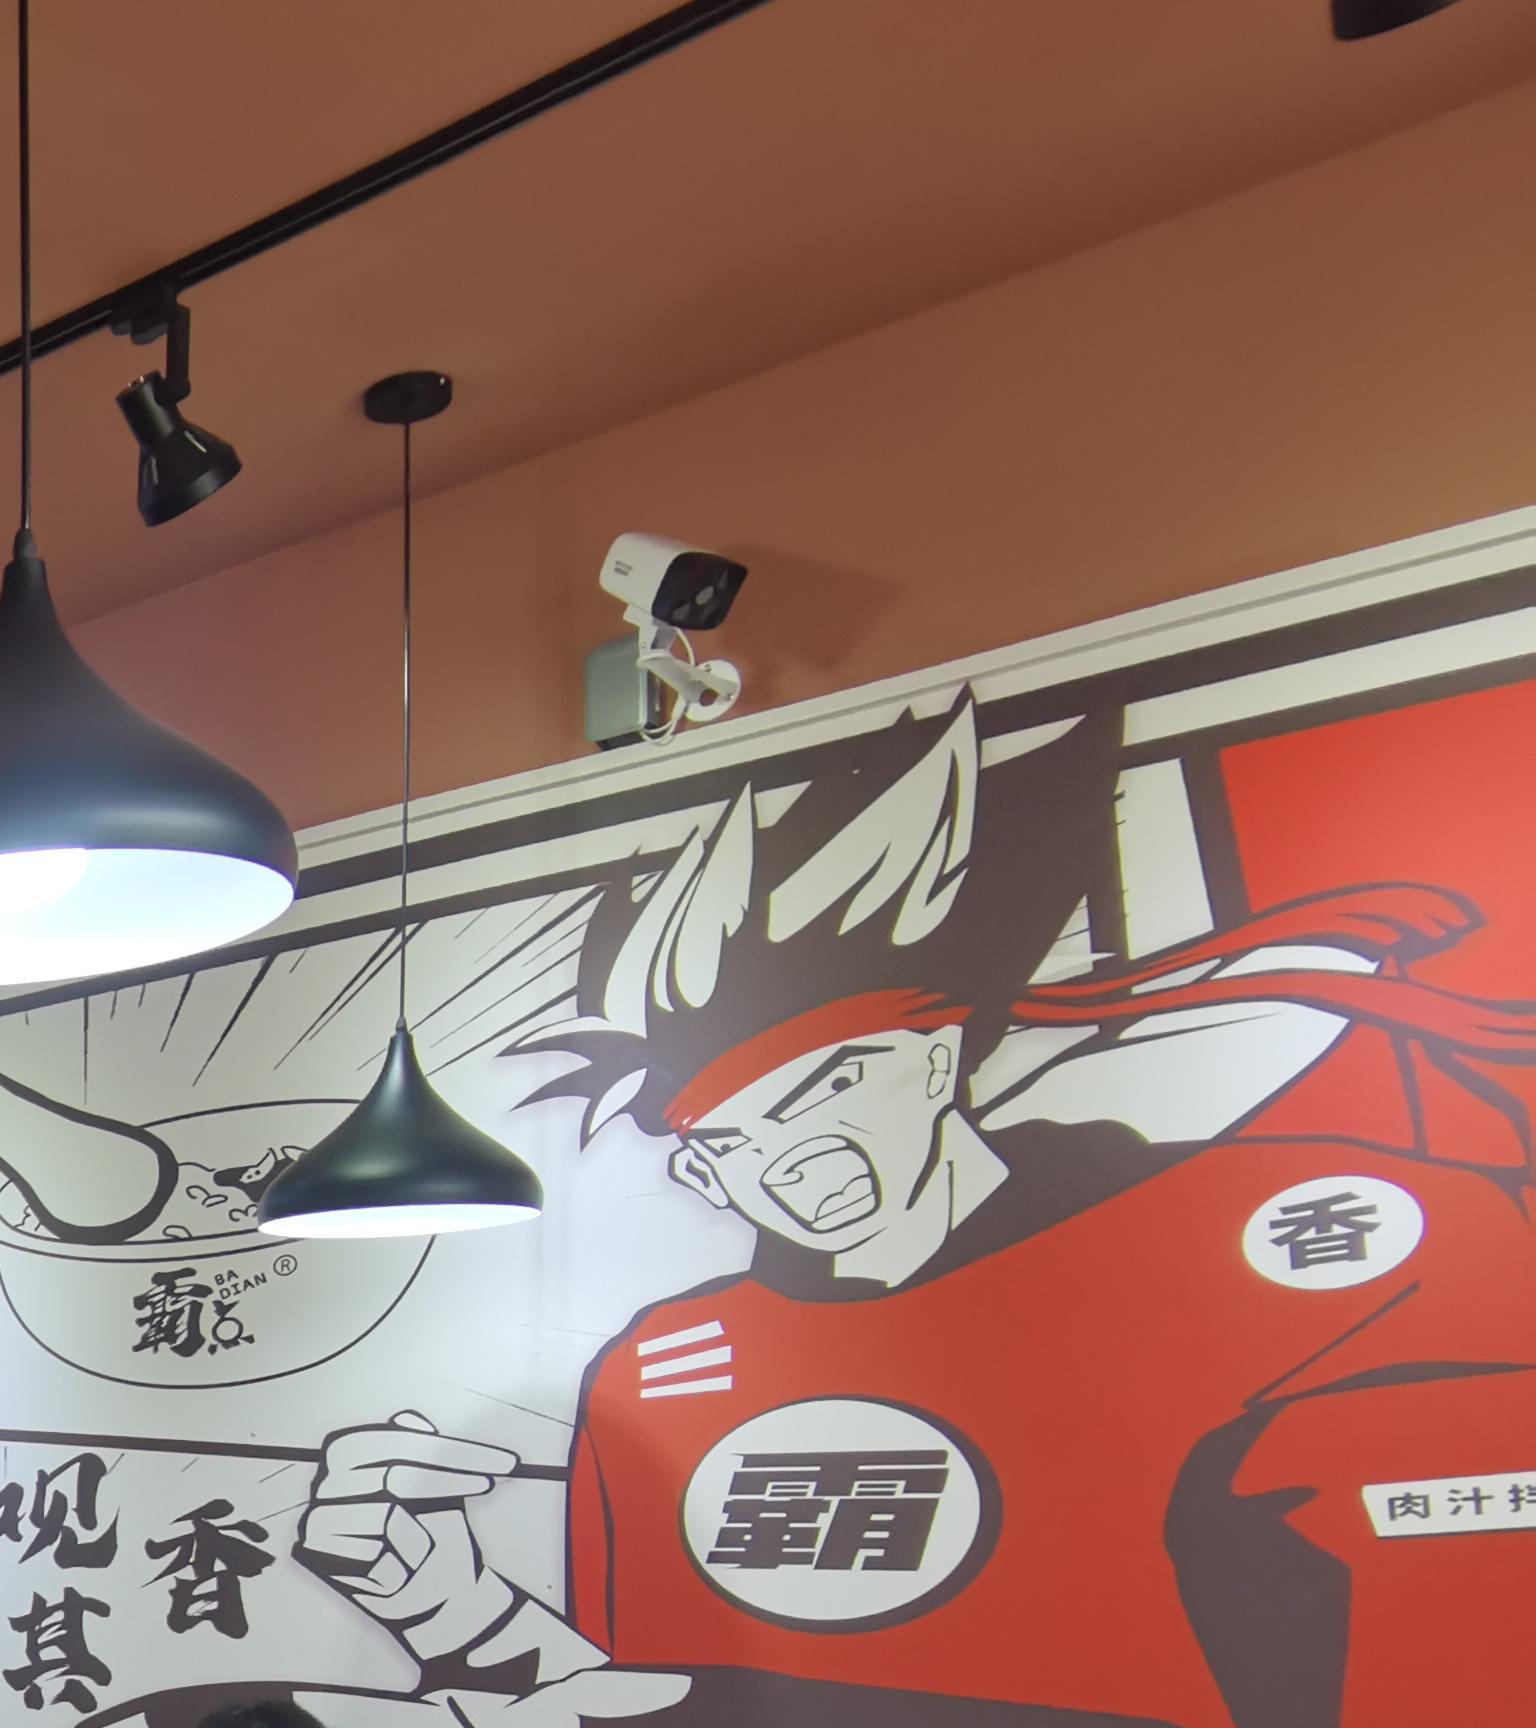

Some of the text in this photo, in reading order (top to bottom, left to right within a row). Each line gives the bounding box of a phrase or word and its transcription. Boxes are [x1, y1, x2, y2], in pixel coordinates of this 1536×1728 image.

[1267, 1190, 1382, 1270] 香
[132, 1267, 256, 1358] 霸点
[213, 1269, 239, 1286] BA
[218, 1271, 268, 1300] DIAN
[706, 1449, 949, 1571] 霸
